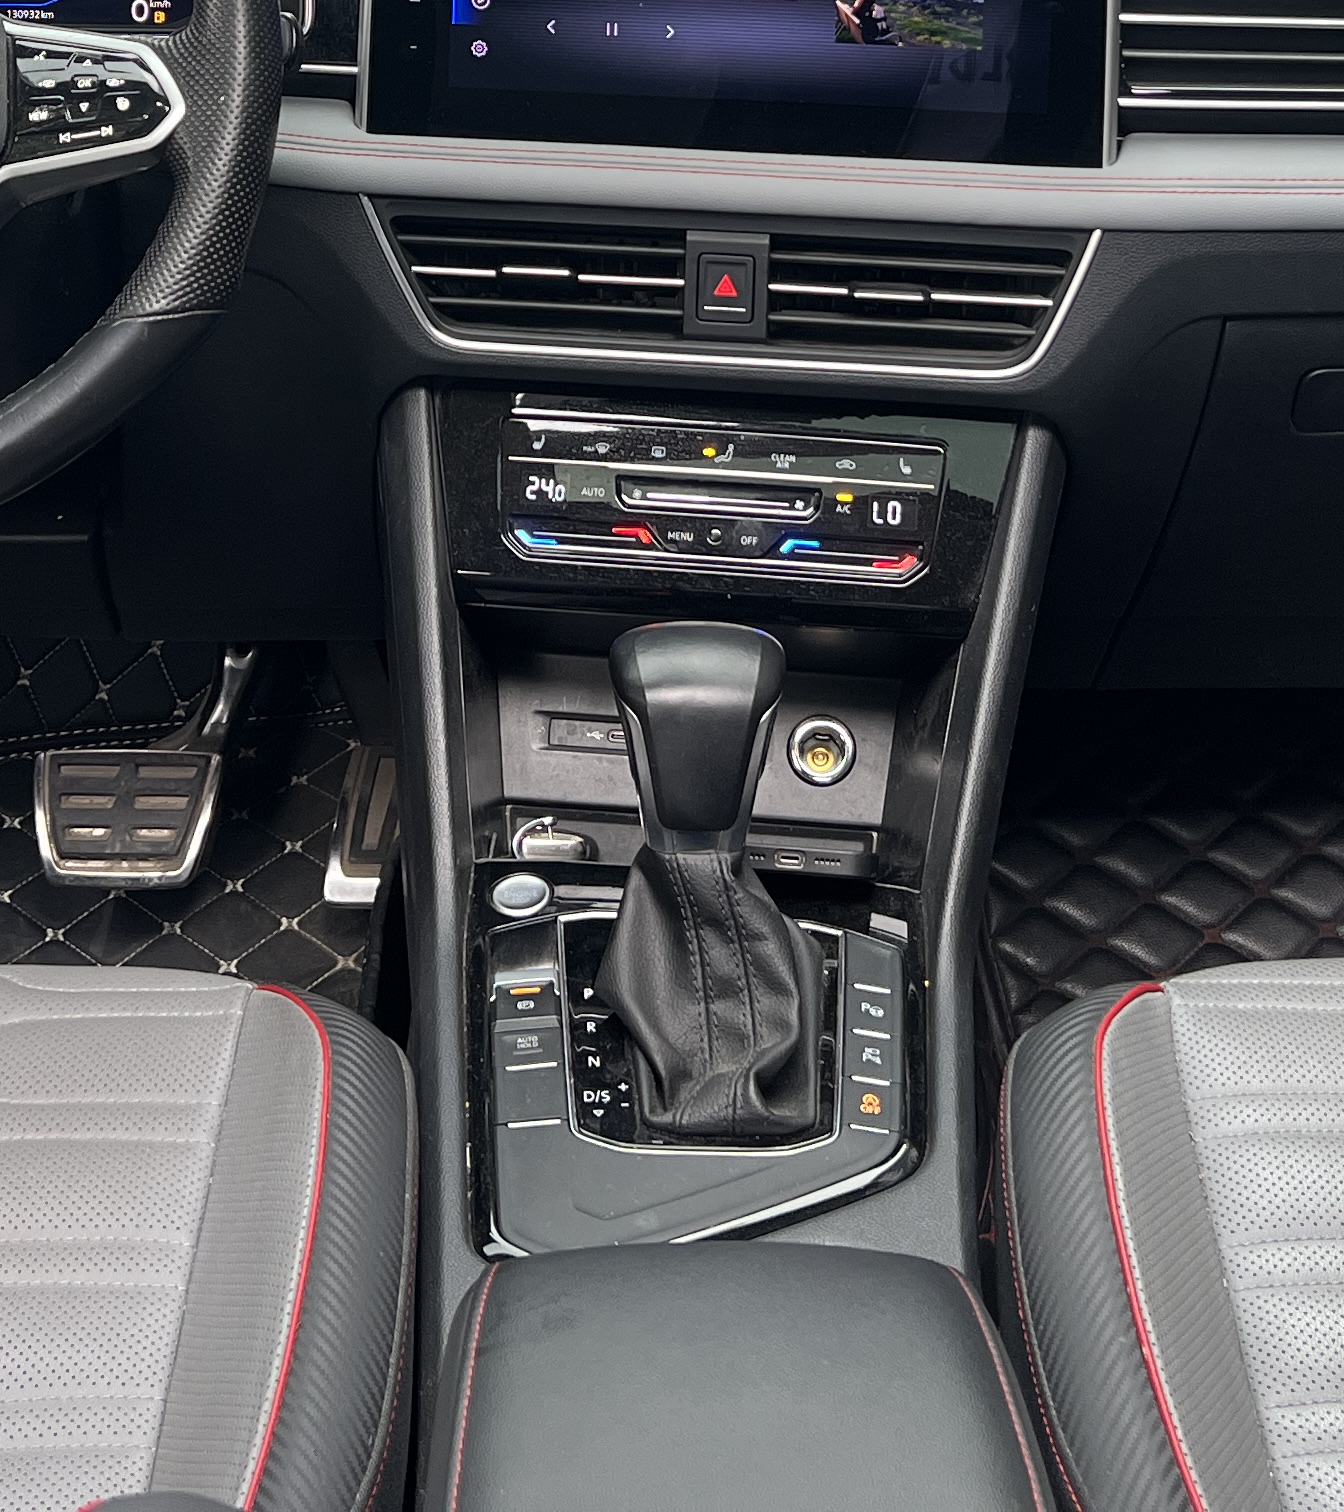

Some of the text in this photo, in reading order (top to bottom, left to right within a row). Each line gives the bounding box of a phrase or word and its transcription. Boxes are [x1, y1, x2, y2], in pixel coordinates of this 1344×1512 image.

[76, 78, 93, 89] OK
[770, 453, 797, 464] CLEAN
[525, 475, 566, 502] 24.0
[581, 486, 606, 498] AUTO
[836, 503, 852, 515] A/C
[667, 530, 694, 542] MENU
[740, 535, 758, 546] OFF
[582, 987, 594, 1000] P
[586, 1021, 597, 1033] R
[516, 1035, 539, 1044] AUTO
[516, 1042, 539, 1050] HOLD
[587, 1055, 601, 1068] N
[583, 1089, 611, 1104] D/S
